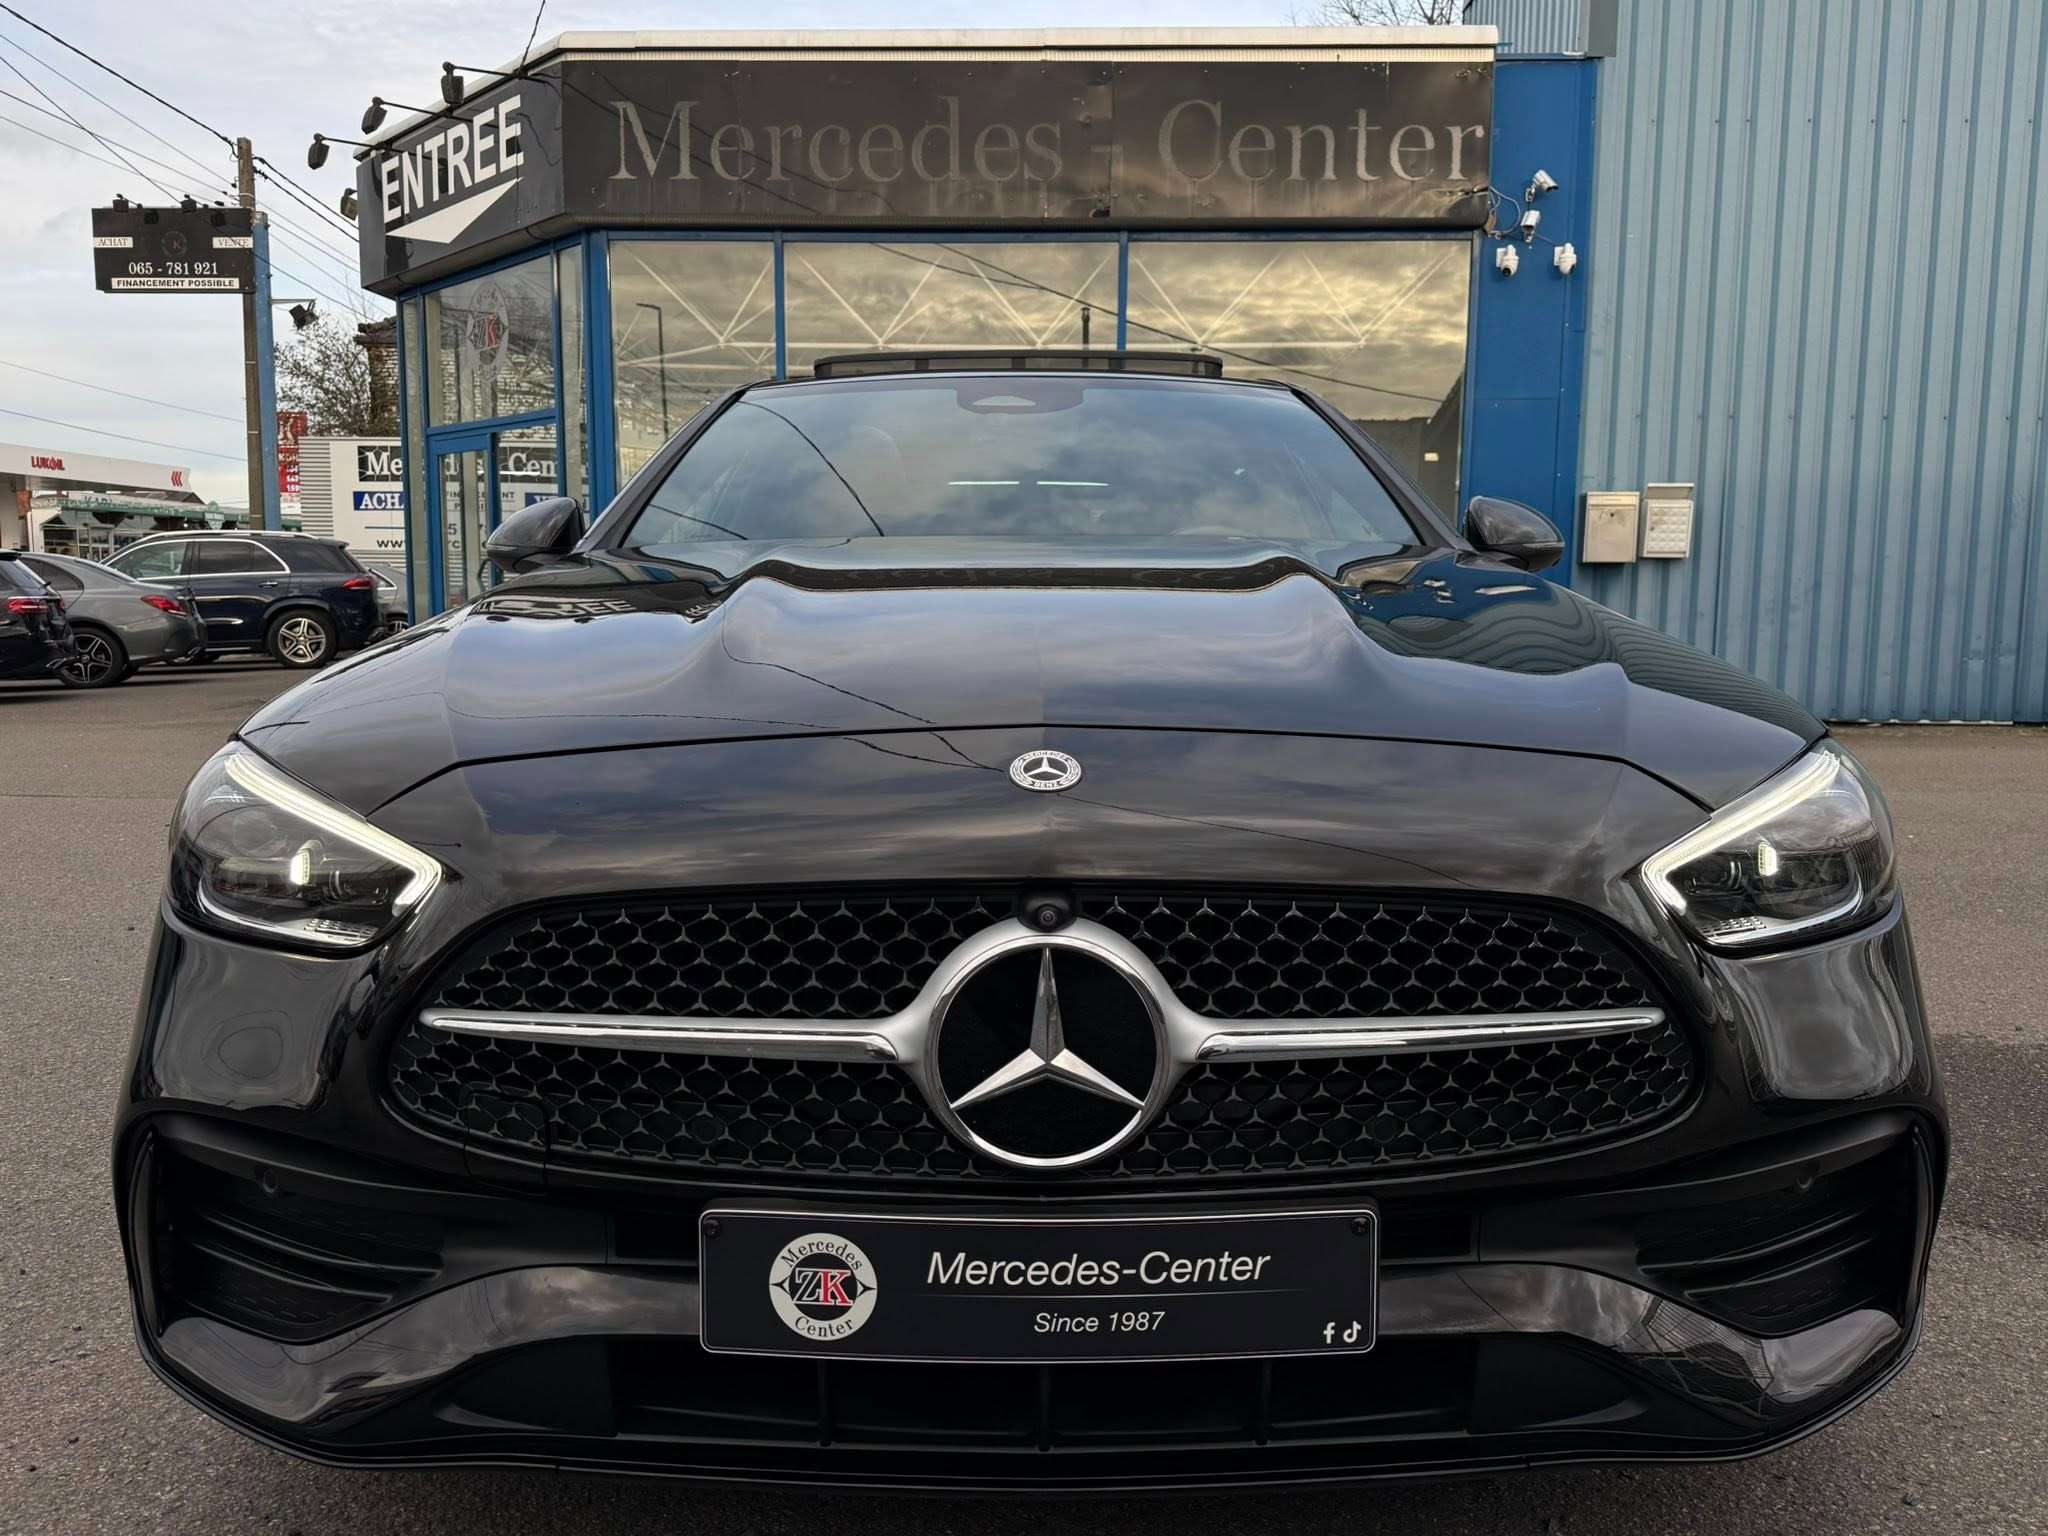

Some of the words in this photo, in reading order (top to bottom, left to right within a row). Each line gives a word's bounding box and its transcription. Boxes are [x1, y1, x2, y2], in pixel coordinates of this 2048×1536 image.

[609, 95, 1063, 183] Mercedes
[1158, 99, 1485, 183] Center
[381, 94, 524, 224] ENTREE
[97, 237, 128, 247] ACHAT
[217, 237, 249, 248] VENTE
[128, 261, 153, 275] 065
[166, 261, 189, 275] 781
[194, 261, 218, 275] 921
[116, 279, 186, 287] FINANCEMENT
[188, 279, 235, 287] POSSIBLE
[780, 1240, 863, 1271] Mercedes
[926, 1250, 1272, 1286] Mercedes-Center
[792, 1267, 855, 1307] ZK
[795, 1315, 854, 1337] Center
[1033, 1312, 1099, 1333] Since
[1108, 1310, 1166, 1332] 1987
